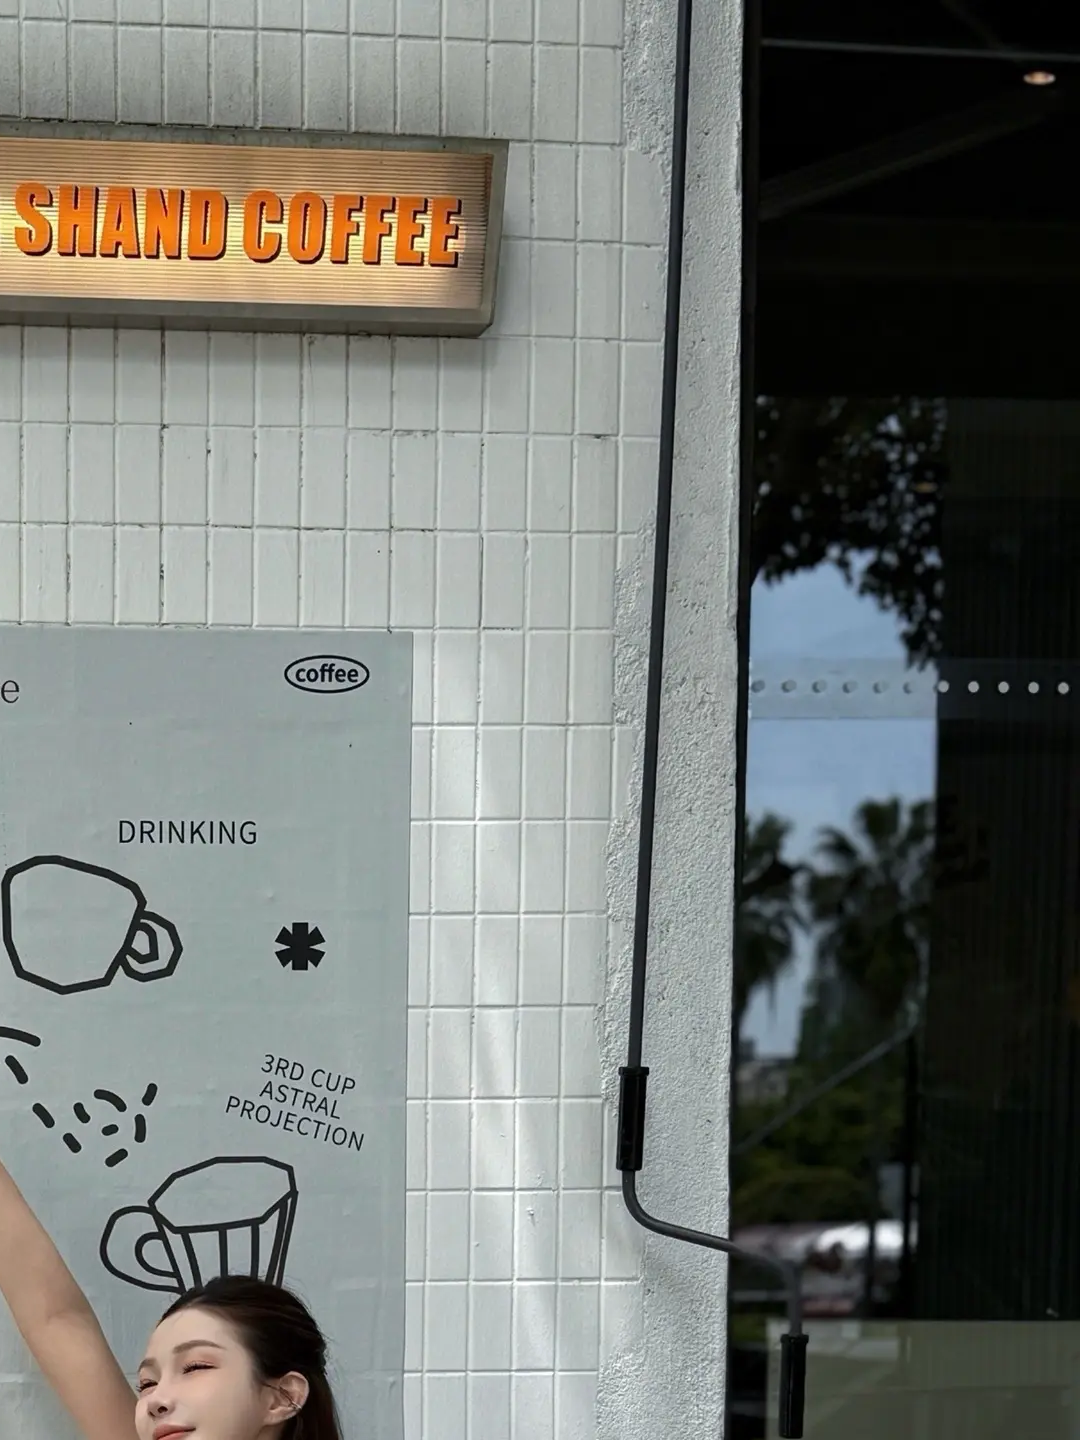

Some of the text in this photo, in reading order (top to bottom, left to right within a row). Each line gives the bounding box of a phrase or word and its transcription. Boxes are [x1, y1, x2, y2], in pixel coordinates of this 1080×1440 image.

[13, 182, 228, 260] SHAND
[242, 188, 462, 268] COFFEE
[295, 662, 360, 685] coffee
[119, 821, 256, 844] DRINKING
[260, 1053, 356, 1095] 3RD CUP
[259, 1081, 341, 1120] ASTRAL
[225, 1095, 365, 1152] PROJECTION
